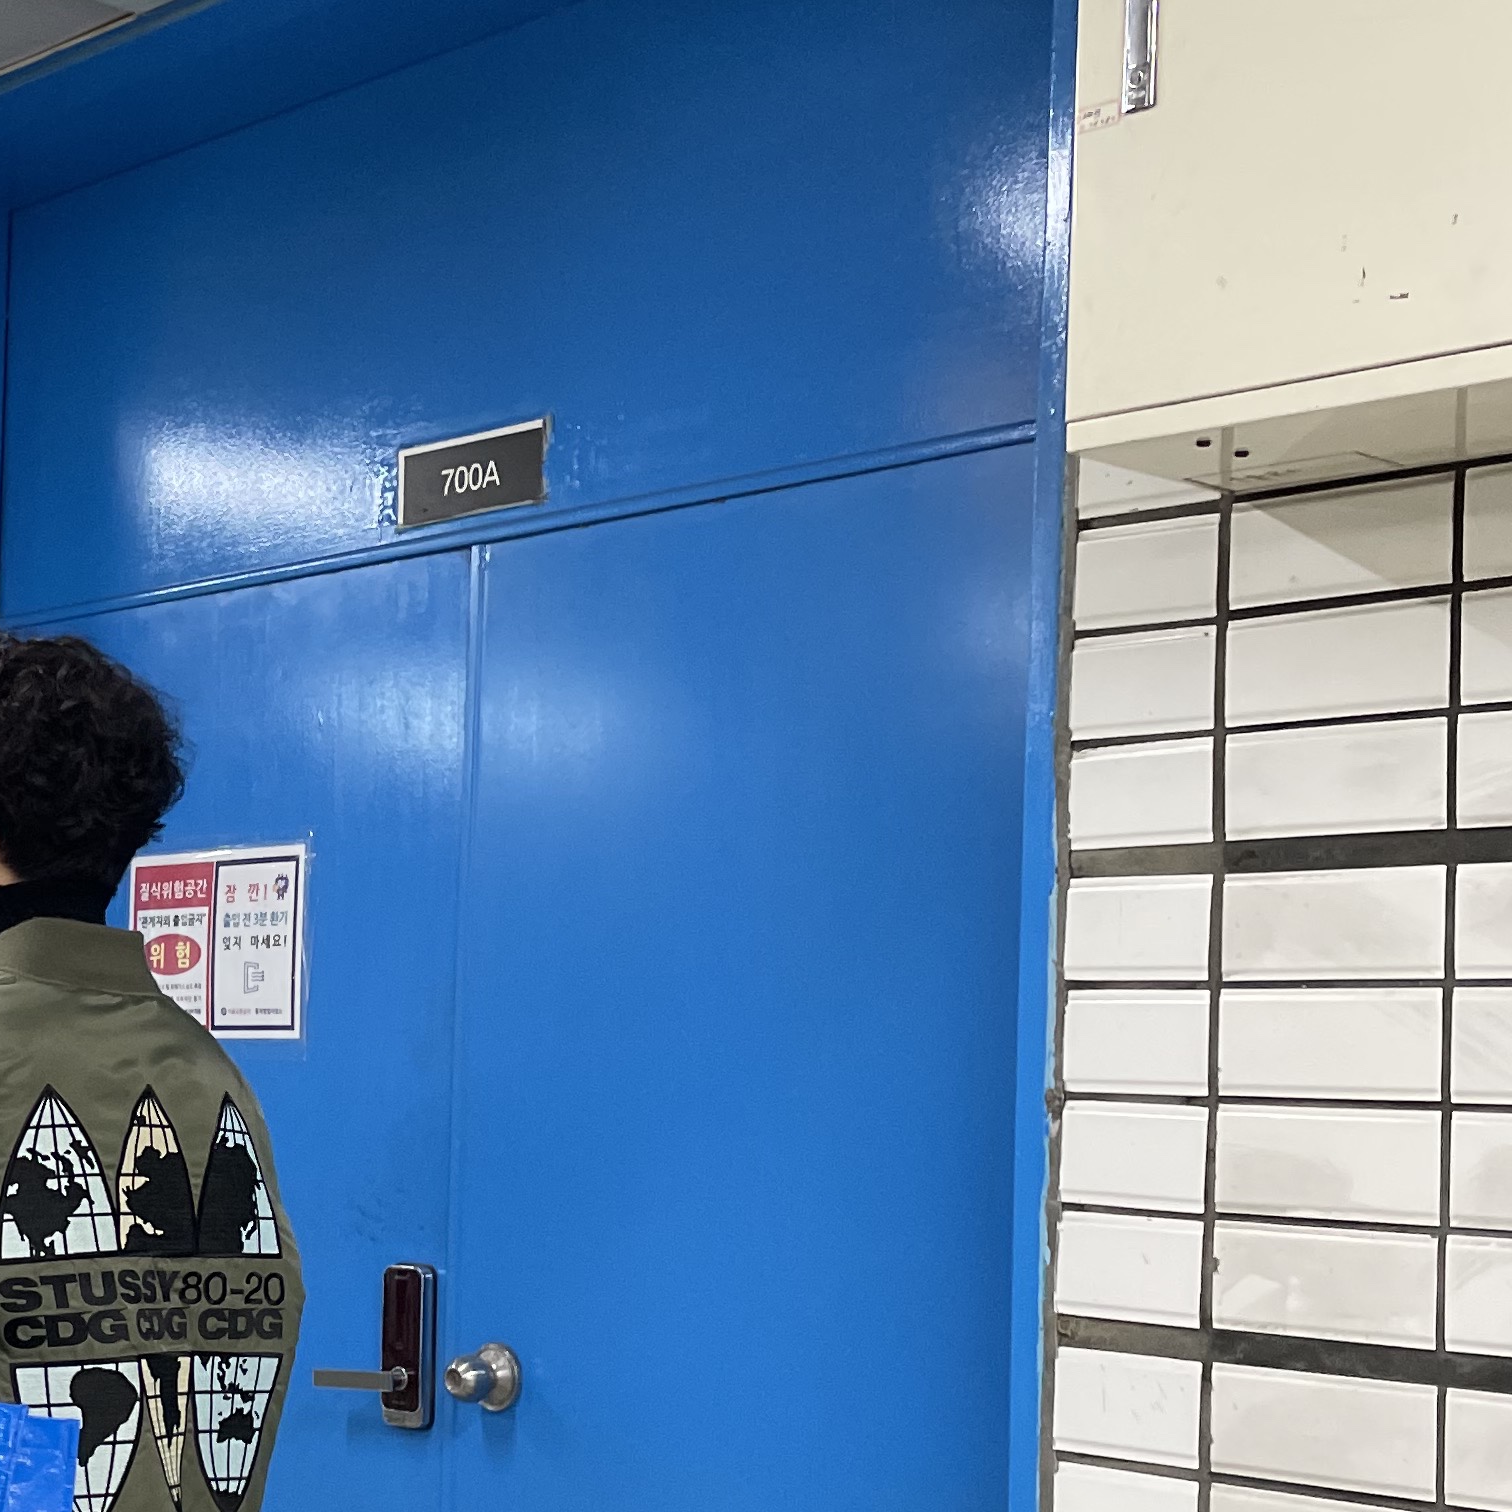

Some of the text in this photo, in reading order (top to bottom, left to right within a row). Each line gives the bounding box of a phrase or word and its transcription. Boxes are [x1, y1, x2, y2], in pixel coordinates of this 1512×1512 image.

[441, 460, 500, 496] 700A
[140, 878, 207, 902] 질식위험공간
[222, 934, 287, 951] 잊지 마세요!
[3, 1307, 283, 1349] CDG CDG CDG
